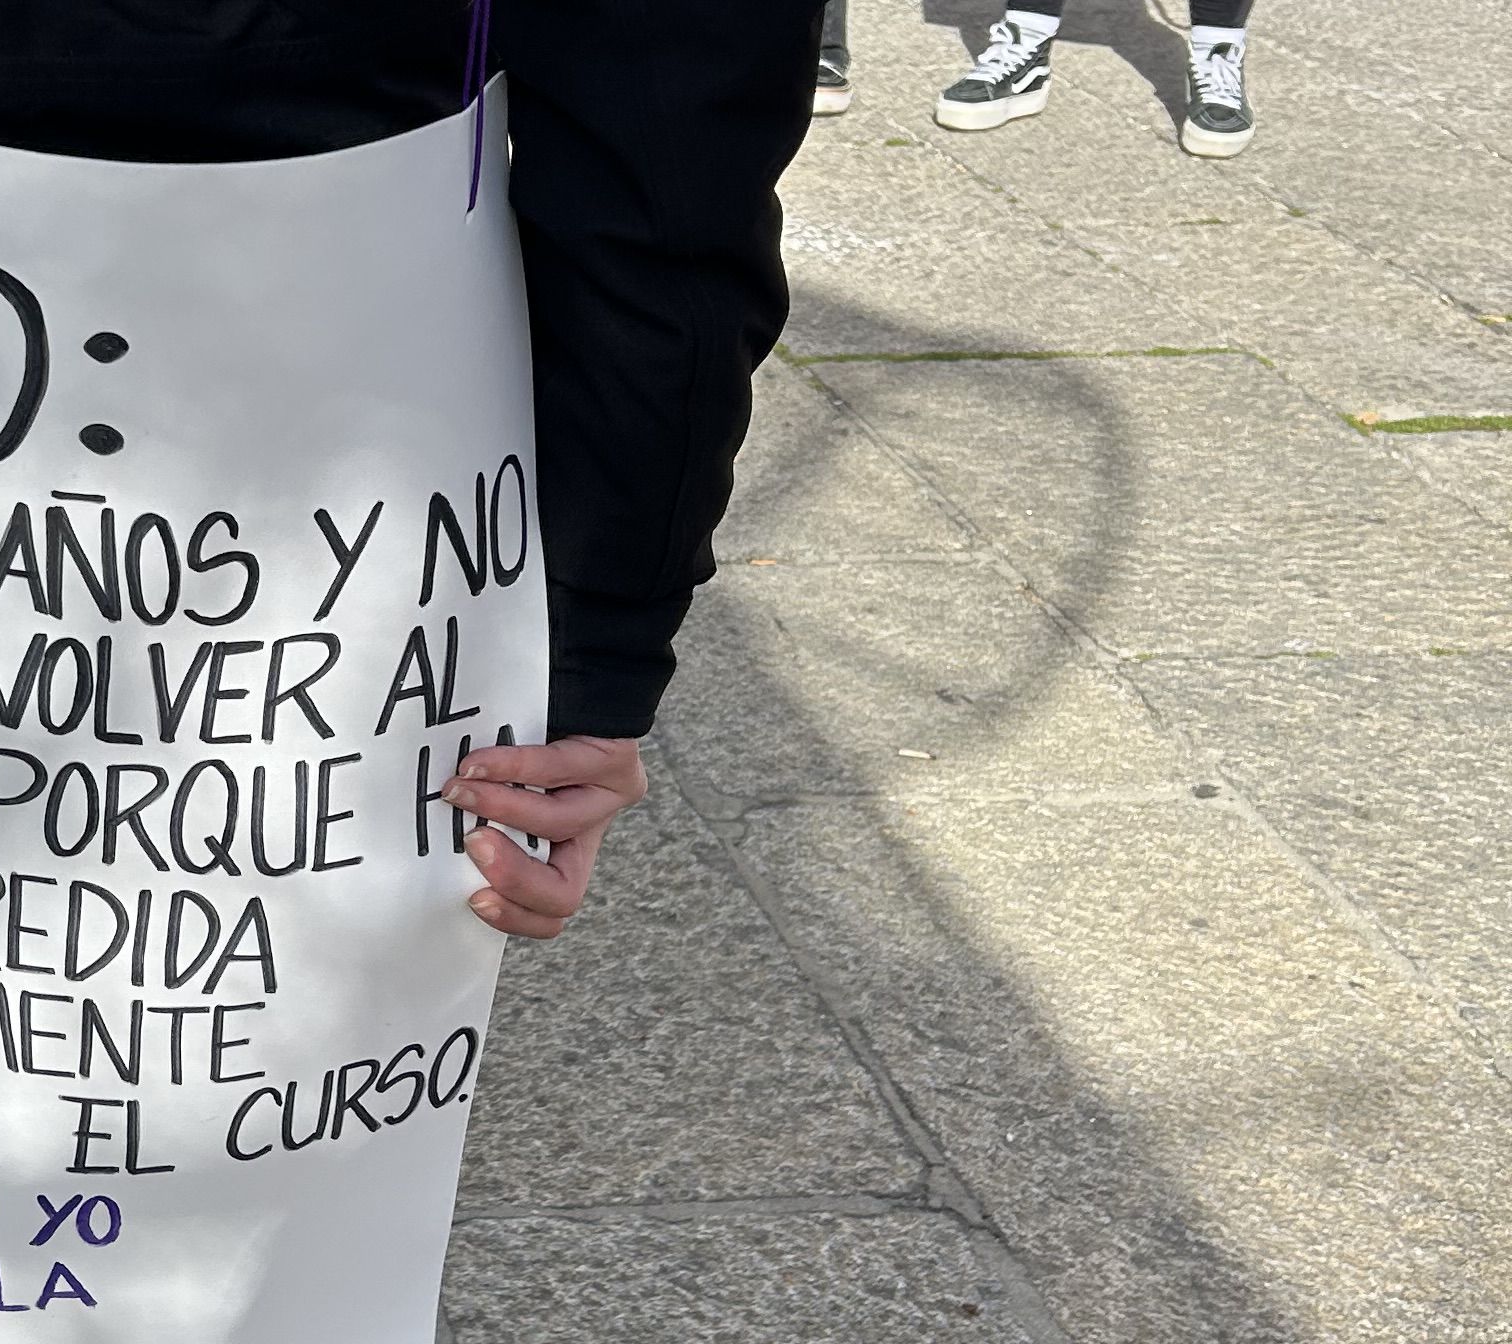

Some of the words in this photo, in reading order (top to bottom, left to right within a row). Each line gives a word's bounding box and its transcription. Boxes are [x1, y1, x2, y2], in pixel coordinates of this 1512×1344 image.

[314, 501, 384, 621] Y
[419, 454, 527, 607] NO
[375, 615, 480, 736] AL
[58, 1095, 176, 1175] EL
[225, 1026, 479, 1161] CURSO.
[29, 1194, 122, 1246] YO
